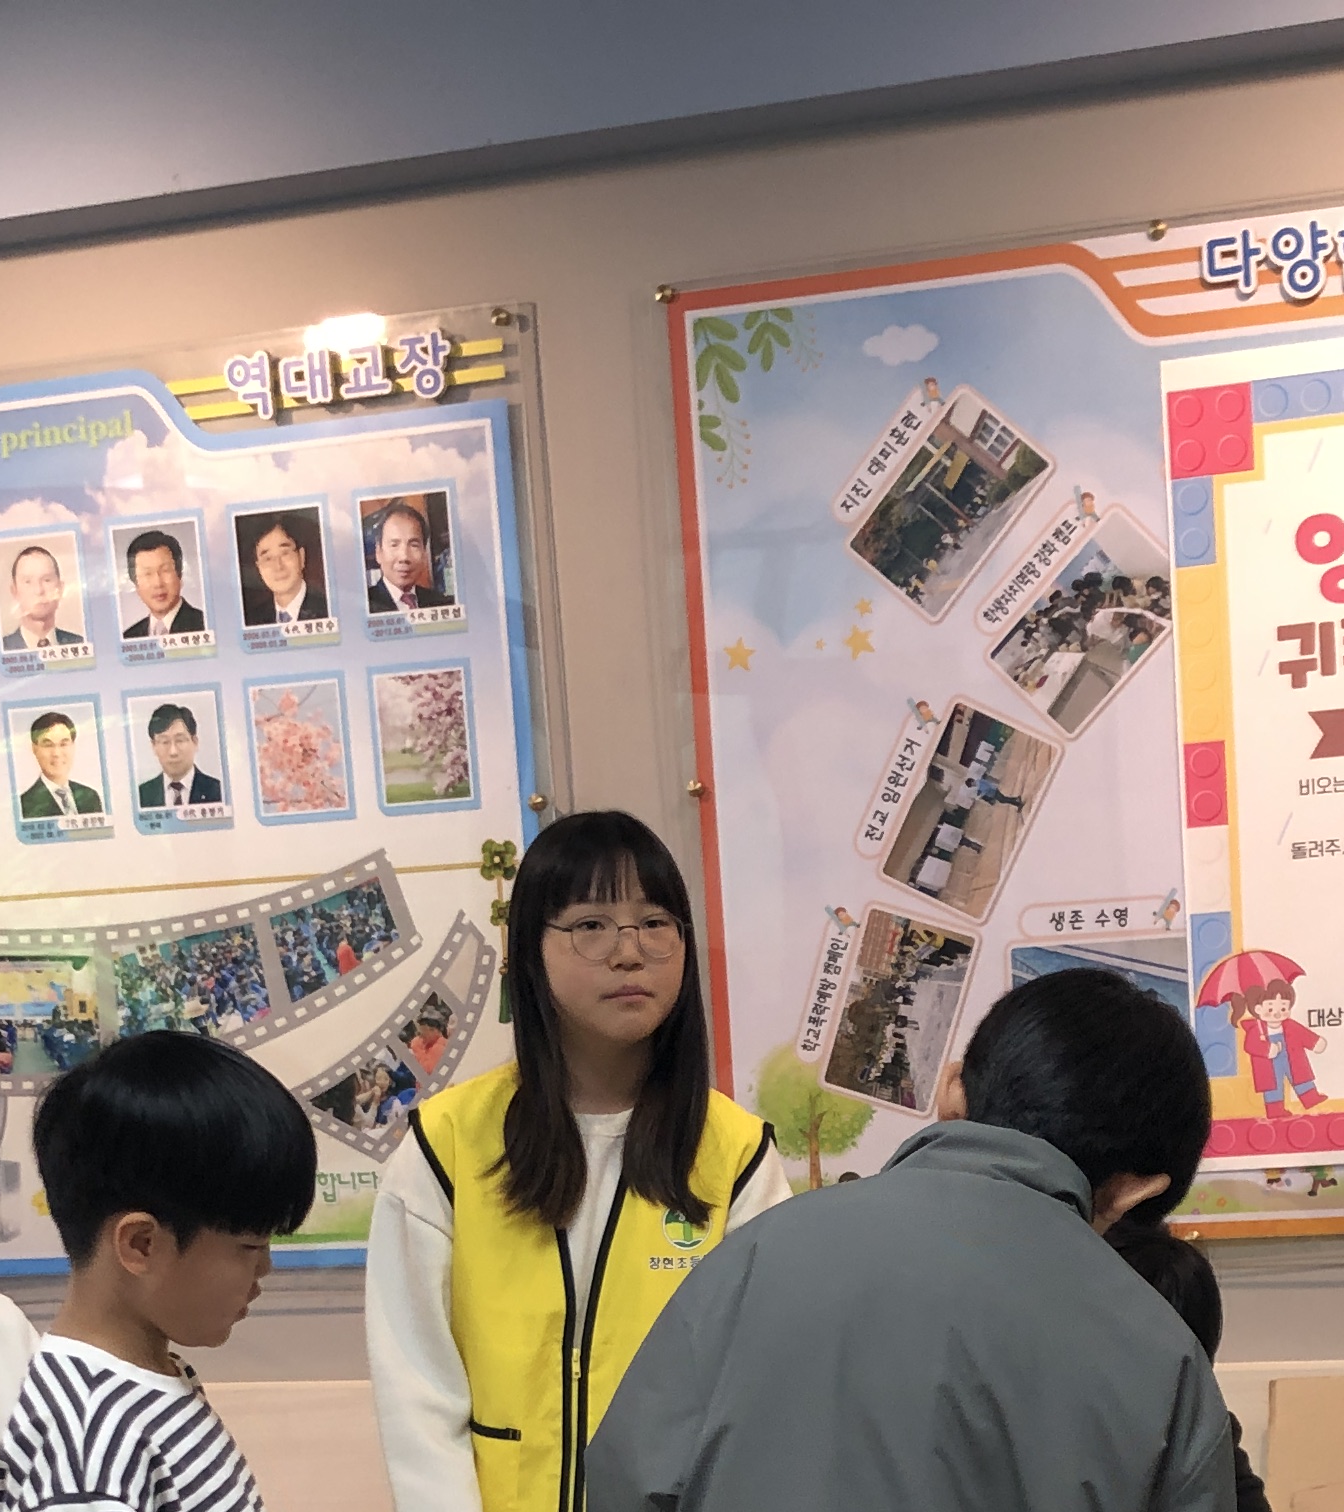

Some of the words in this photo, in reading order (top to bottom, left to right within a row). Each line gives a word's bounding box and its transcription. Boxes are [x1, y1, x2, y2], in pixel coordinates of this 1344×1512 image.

[226, 330, 449, 418] 역대교장
[0, 410, 133, 459] principal
[840, 477, 872, 513] 지진
[867, 410, 922, 476] 대피훈련
[982, 561, 1041, 623] 학생자치역량
[1033, 540, 1059, 566] 강화
[1051, 519, 1077, 545] 캠프
[864, 810, 890, 841] 전교
[881, 737, 922, 803] 임원선거
[1049, 910, 1085, 932] 생존
[1095, 907, 1128, 927] 수영
[801, 978, 837, 1051] 학교폭력예방
[823, 938, 849, 975] 캠페인
[1308, 1007, 1344, 1028] 대상
[649, 1255, 702, 1271] 창현초등
